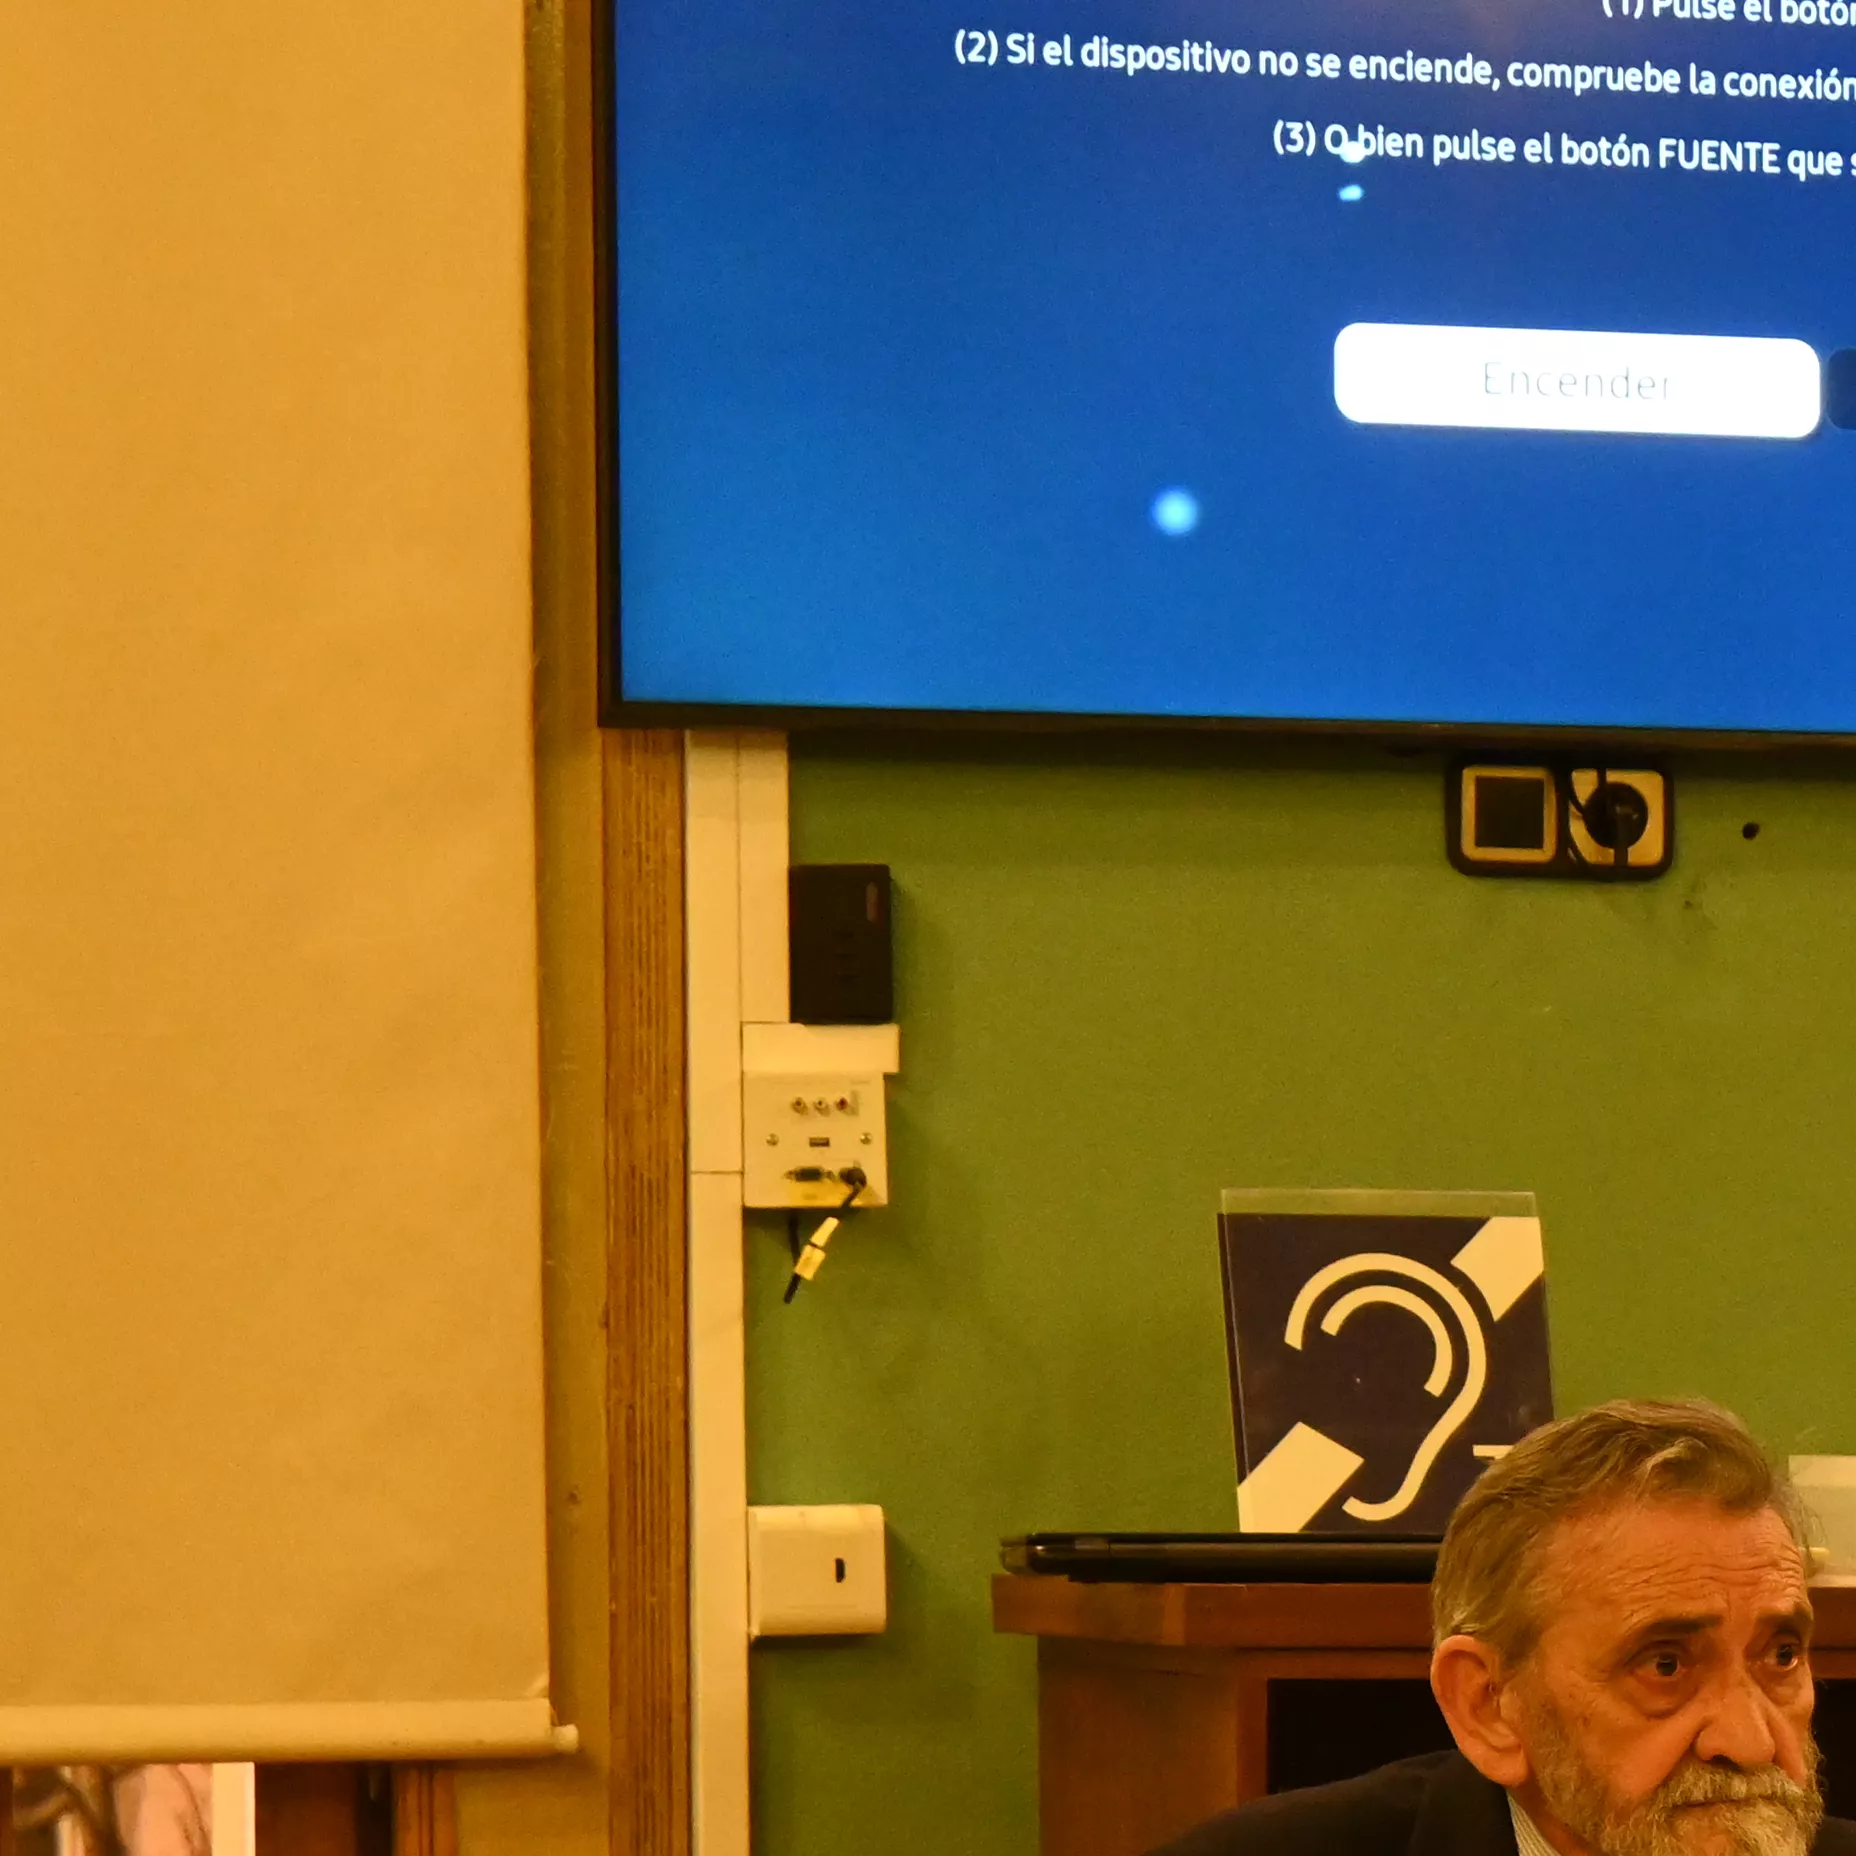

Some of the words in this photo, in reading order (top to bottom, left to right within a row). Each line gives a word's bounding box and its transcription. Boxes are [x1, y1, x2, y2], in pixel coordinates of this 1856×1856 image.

[1653, 0, 1735, 20] Pulse
[1744, 0, 1772, 22] el
[955, 29, 998, 65] (2)
[1007, 33, 1034, 64] Si
[1043, 34, 1073, 66] el
[1081, 36, 1250, 76] dispositivo
[1259, 51, 1298, 76] no
[1306, 53, 1341, 78] se
[1349, 50, 1500, 91] enciende,
[1507, 61, 1681, 96] compruebe
[1690, 63, 1716, 95] la
[1274, 120, 1316, 156] (3)
[1358, 124, 1423, 158] bien
[1433, 129, 1516, 166] pulse
[1524, 132, 1553, 163] el
[1562, 133, 1649, 167] botón
[1659, 138, 1780, 173] FUENTE
[1788, 150, 1843, 181] que
[1482, 361, 1672, 400] Encender
